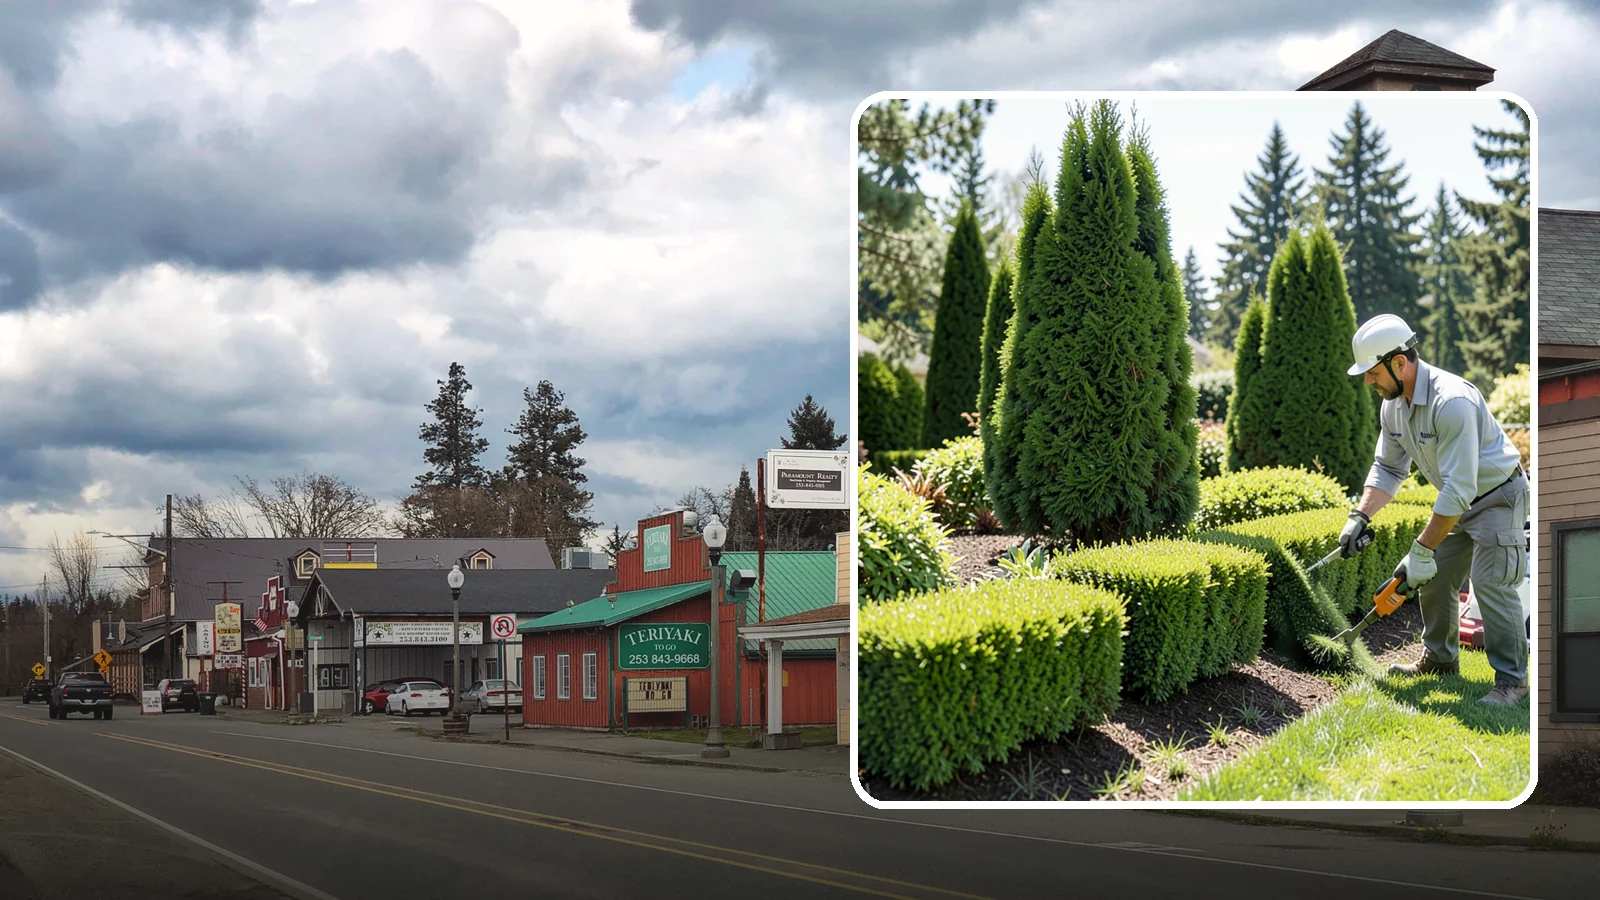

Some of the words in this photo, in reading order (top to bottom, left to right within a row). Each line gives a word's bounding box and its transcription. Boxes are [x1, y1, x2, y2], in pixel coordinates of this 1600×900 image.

[781, 471, 815, 479] PARAMOUNT
[817, 472, 838, 480] REALTY
[625, 627, 703, 646] TERIYAKI
[653, 643, 664, 651] TO
[665, 643, 677, 651] GO
[628, 654, 649, 665] 253
[651, 653, 700, 664] 843-9668
